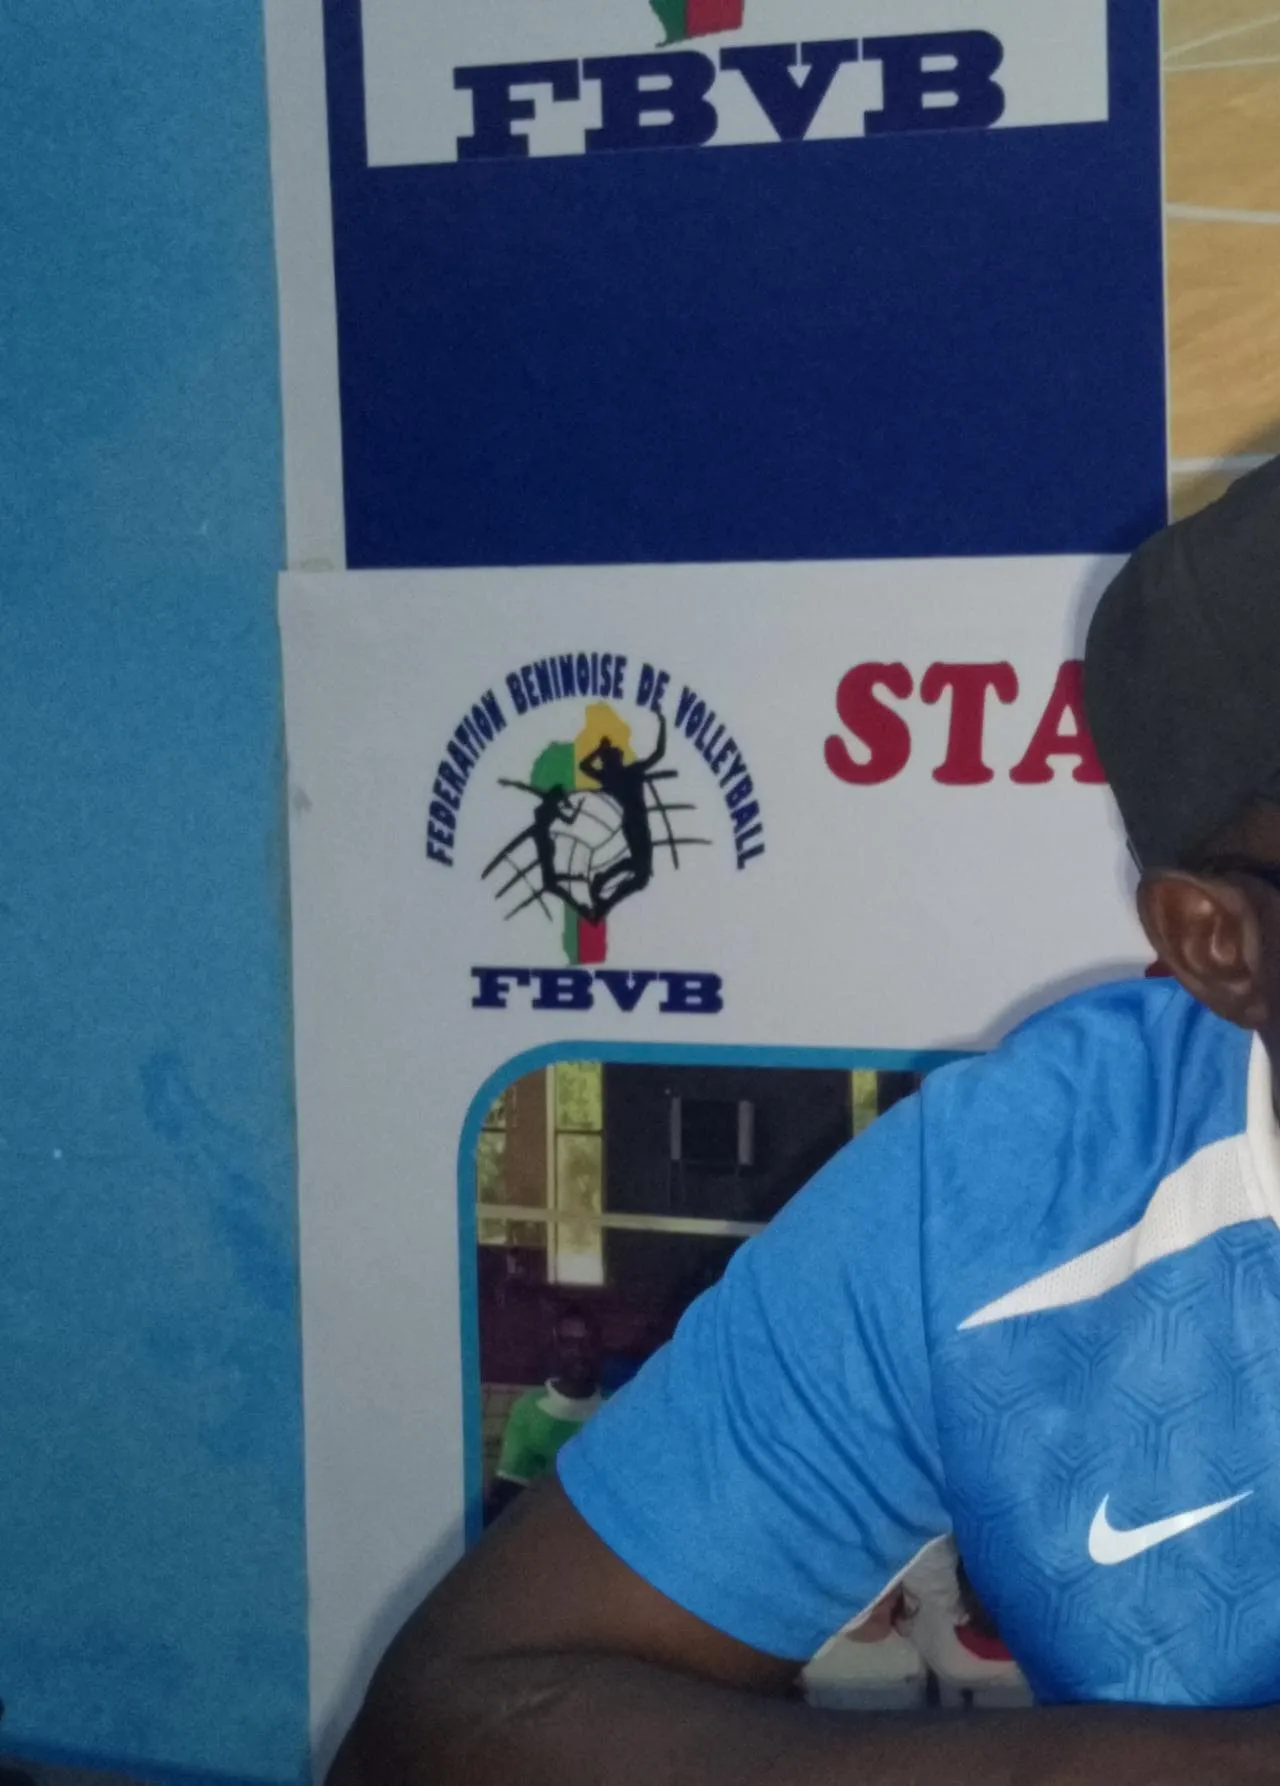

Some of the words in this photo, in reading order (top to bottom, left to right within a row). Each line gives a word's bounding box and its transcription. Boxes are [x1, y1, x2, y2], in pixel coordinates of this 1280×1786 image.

[453, 29, 1006, 162] FBVB
[426, 688, 507, 867] FEDERATION
[505, 652, 627, 716] BENINOISE
[636, 663, 671, 711] DE
[674, 685, 765, 870] VOLLEYBALL
[470, 965, 724, 1015] FBVB
